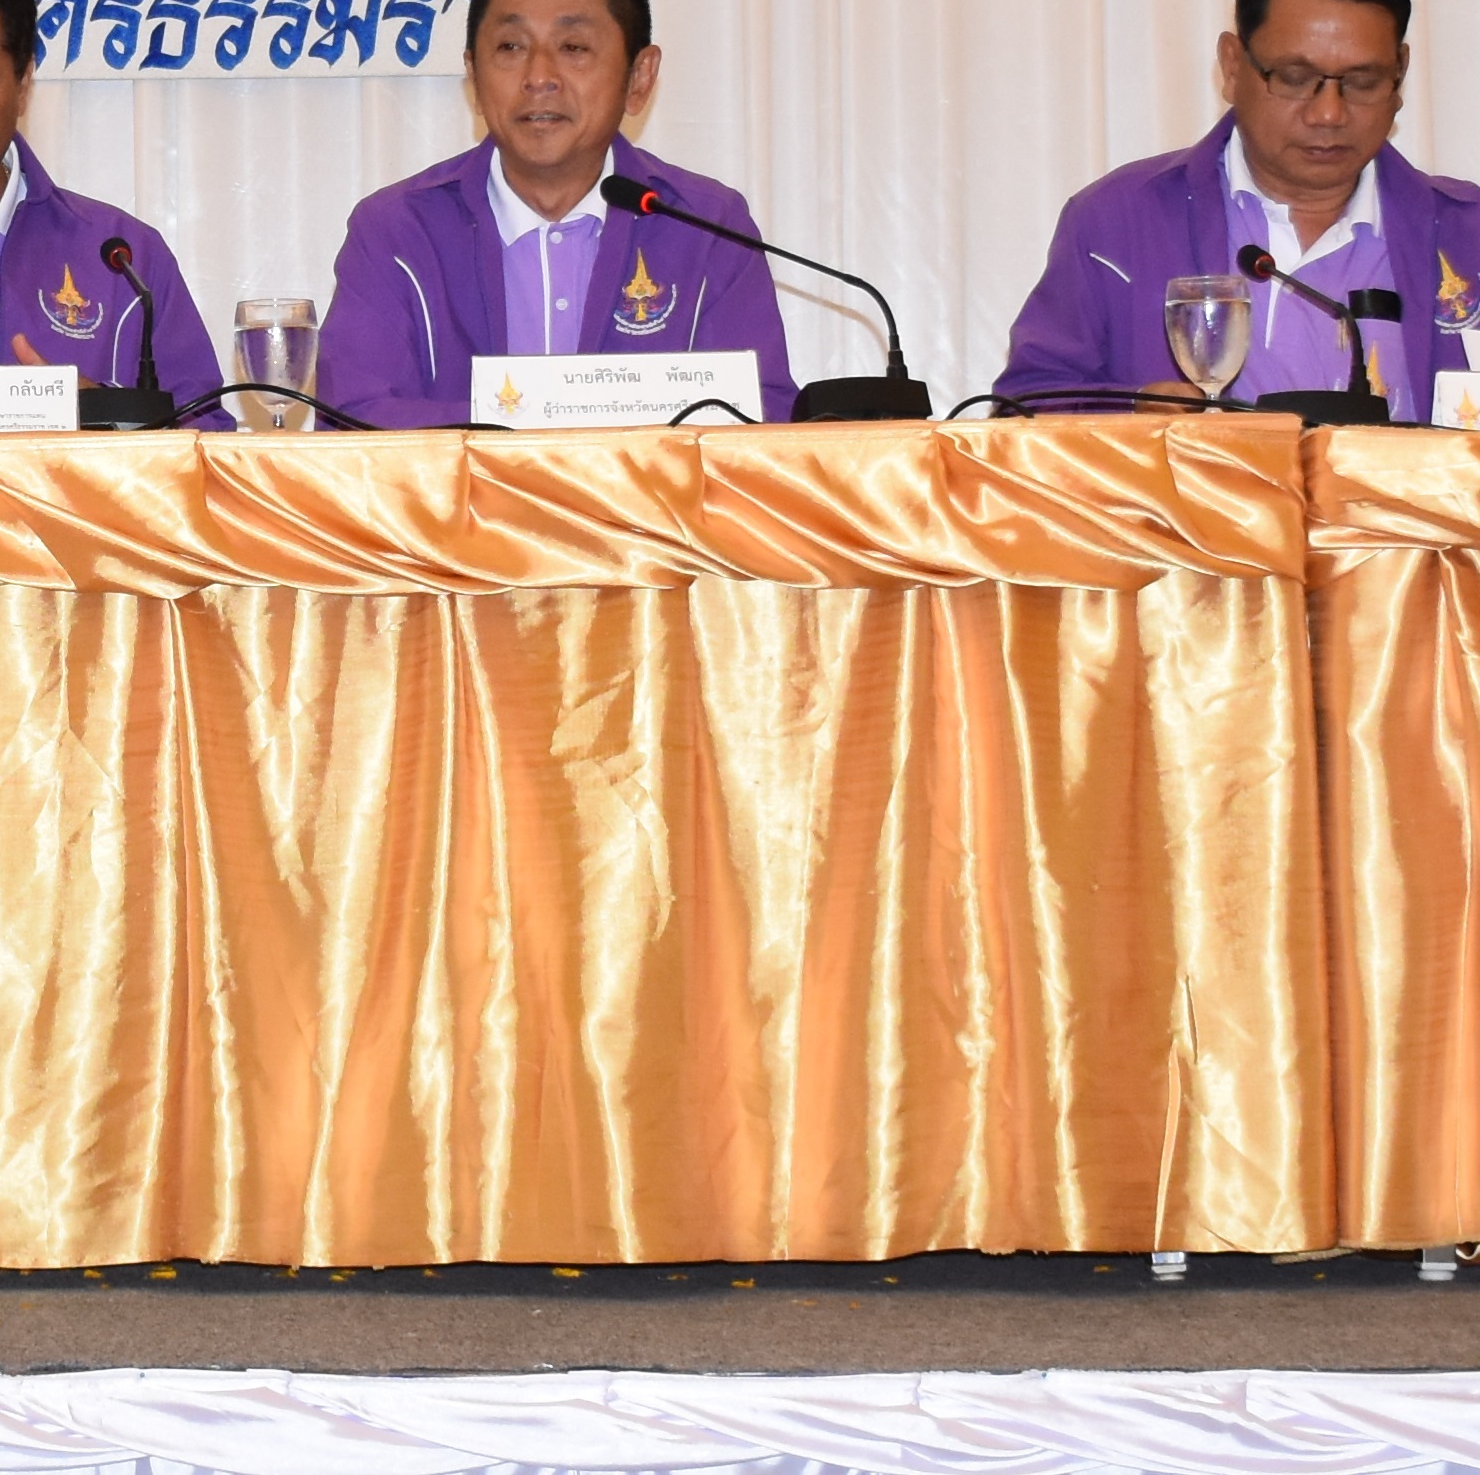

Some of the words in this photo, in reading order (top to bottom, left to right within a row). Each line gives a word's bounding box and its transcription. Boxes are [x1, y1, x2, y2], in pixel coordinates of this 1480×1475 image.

[563, 366, 642, 385] นายศิริพัฒ
[665, 366, 715, 388] พัฒกุล
[9, 379, 64, 398] กลับศรี
